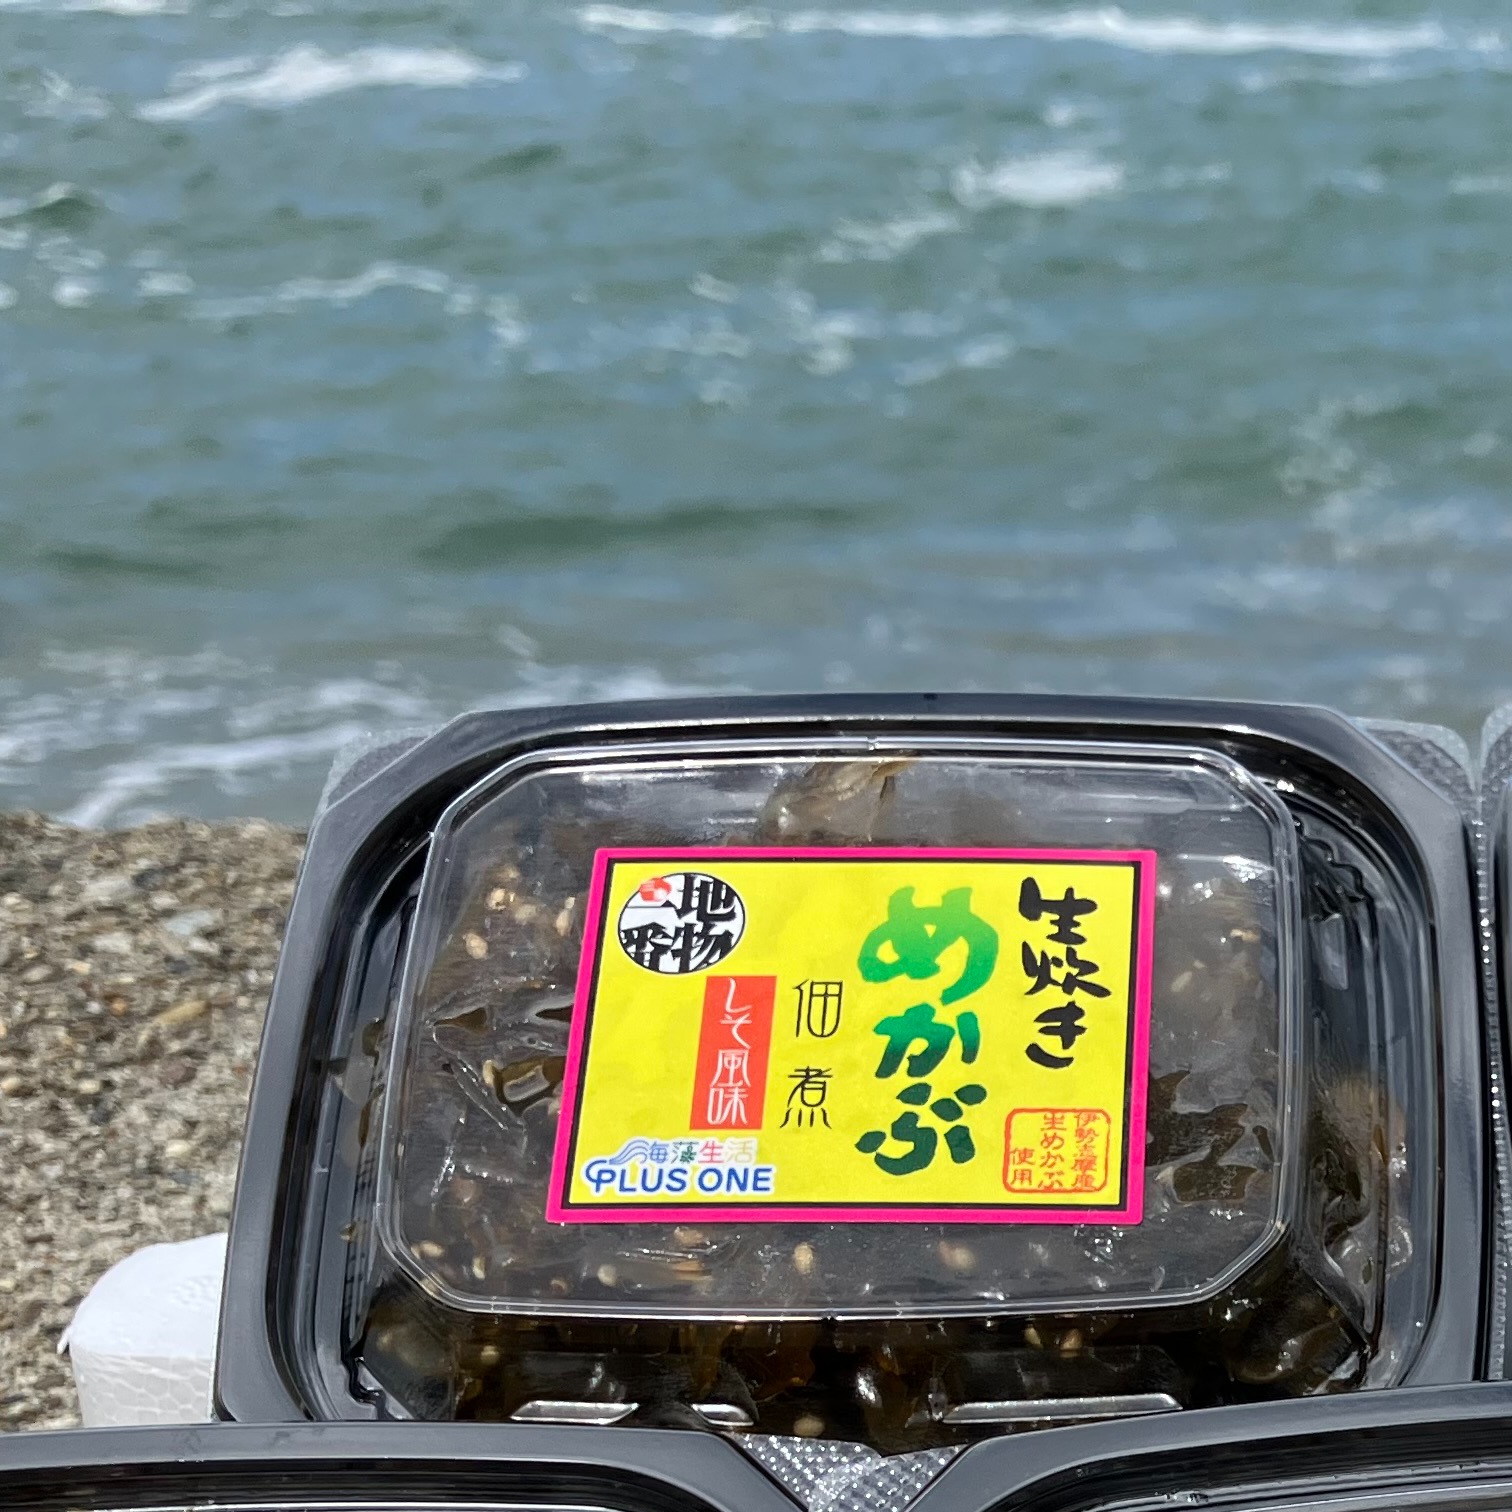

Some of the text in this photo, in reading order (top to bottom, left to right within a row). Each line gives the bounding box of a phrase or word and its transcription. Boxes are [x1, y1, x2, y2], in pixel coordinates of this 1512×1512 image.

[855, 885, 998, 1176] めかぶ
[1018, 877, 1111, 1069] 生炊き
[707, 977, 754, 1126] しそ風味
[779, 978, 843, 1130] 佃煮
[586, 1159, 772, 1192] PLUS ONE
[1010, 1148, 1035, 1185] 使用
